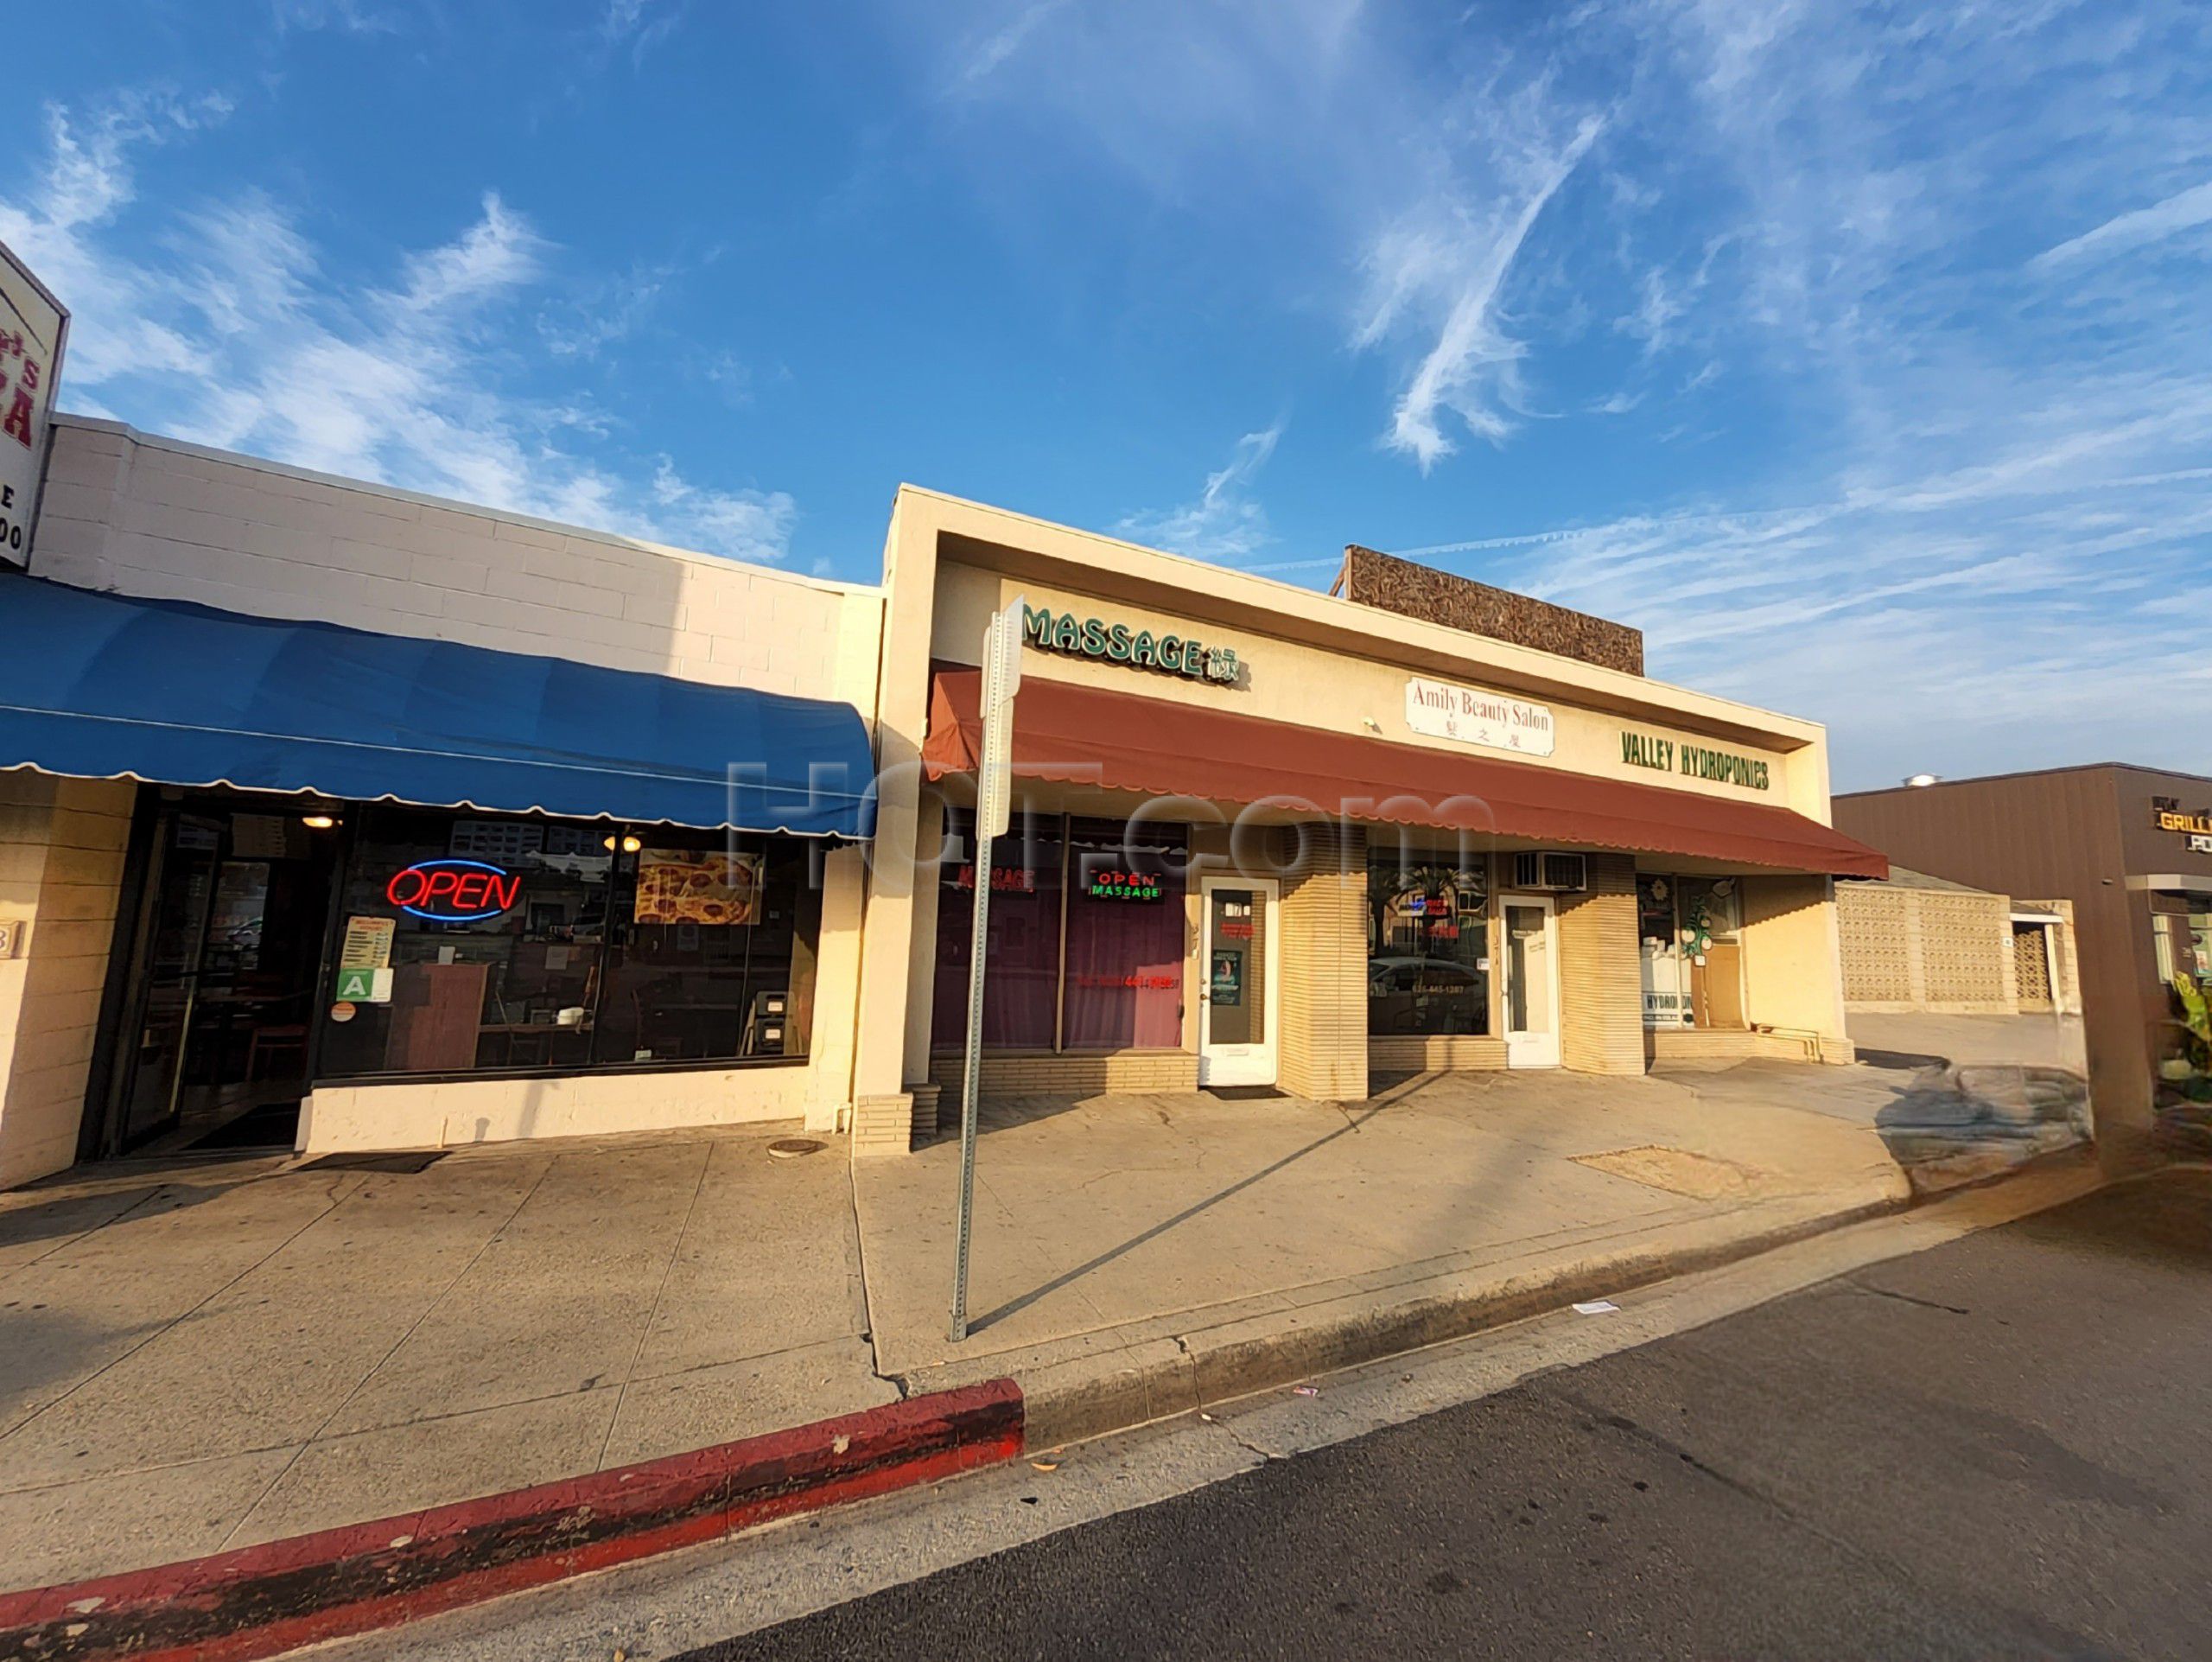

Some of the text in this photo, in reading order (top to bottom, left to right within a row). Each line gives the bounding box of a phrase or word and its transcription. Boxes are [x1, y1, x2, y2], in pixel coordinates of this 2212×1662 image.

[1022, 603, 1204, 676] MASSAGE
[1413, 681, 1548, 731] Amily Beauty Salon
[1621, 731, 1770, 791] VALLEY HYDROPONICS
[387, 869, 521, 910] OPEN
[958, 865, 1034, 893] MSAGE
[1092, 885, 1159, 898] MASSAGE
[1098, 872, 1155, 886] OPEN
[342, 976, 366, 996] A
